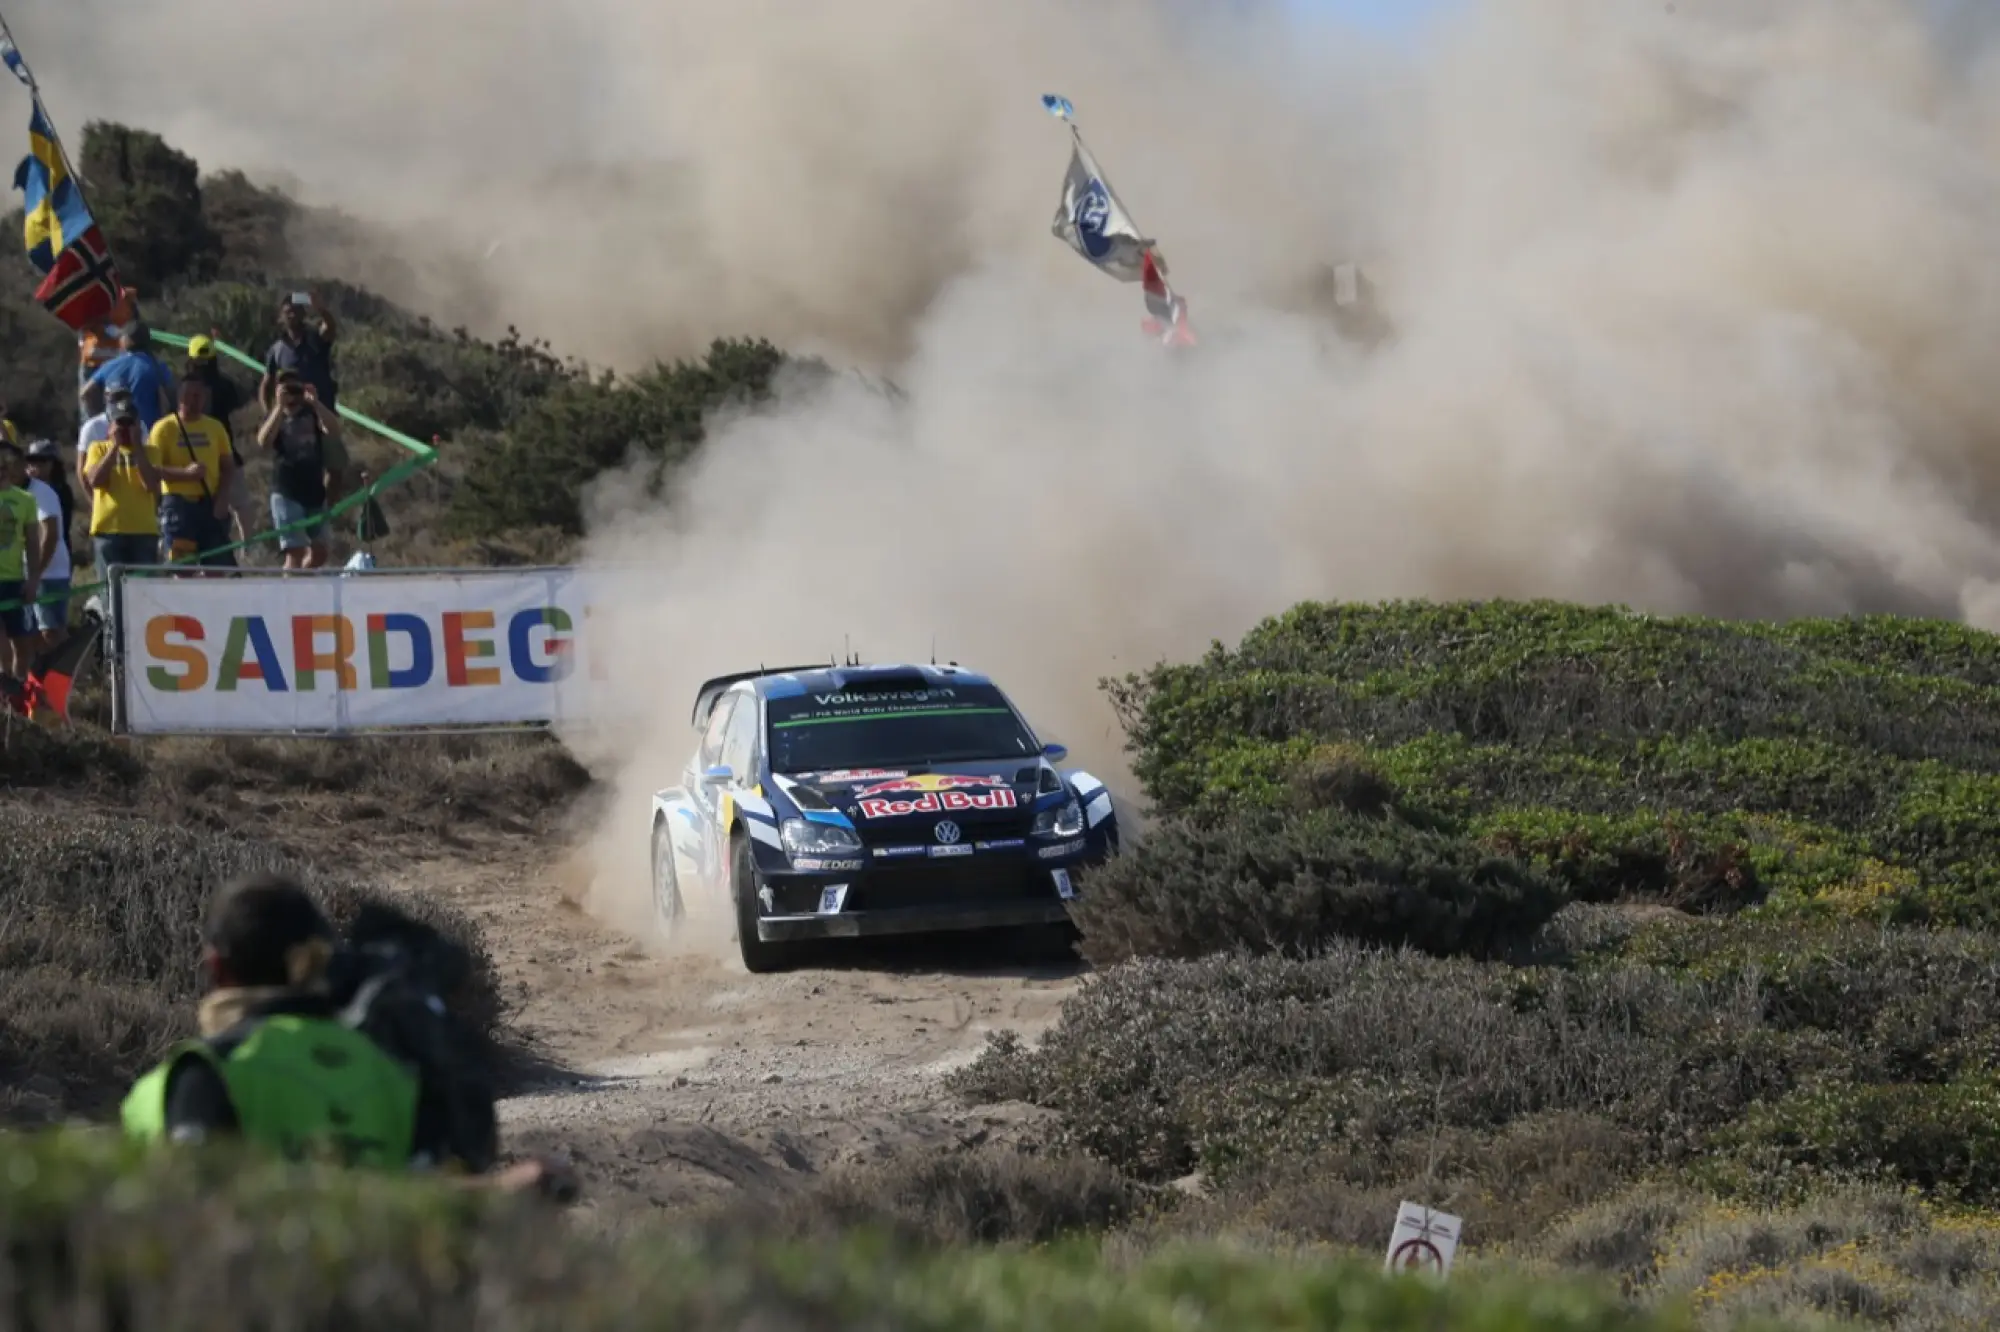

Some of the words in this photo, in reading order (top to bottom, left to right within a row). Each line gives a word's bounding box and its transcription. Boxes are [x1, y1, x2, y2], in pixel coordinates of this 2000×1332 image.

[145, 606, 607, 692] SARDEG
[814, 688, 957, 705] Volkswagen
[858, 792, 941, 819] Red
[941, 789, 1017, 812] Bull
